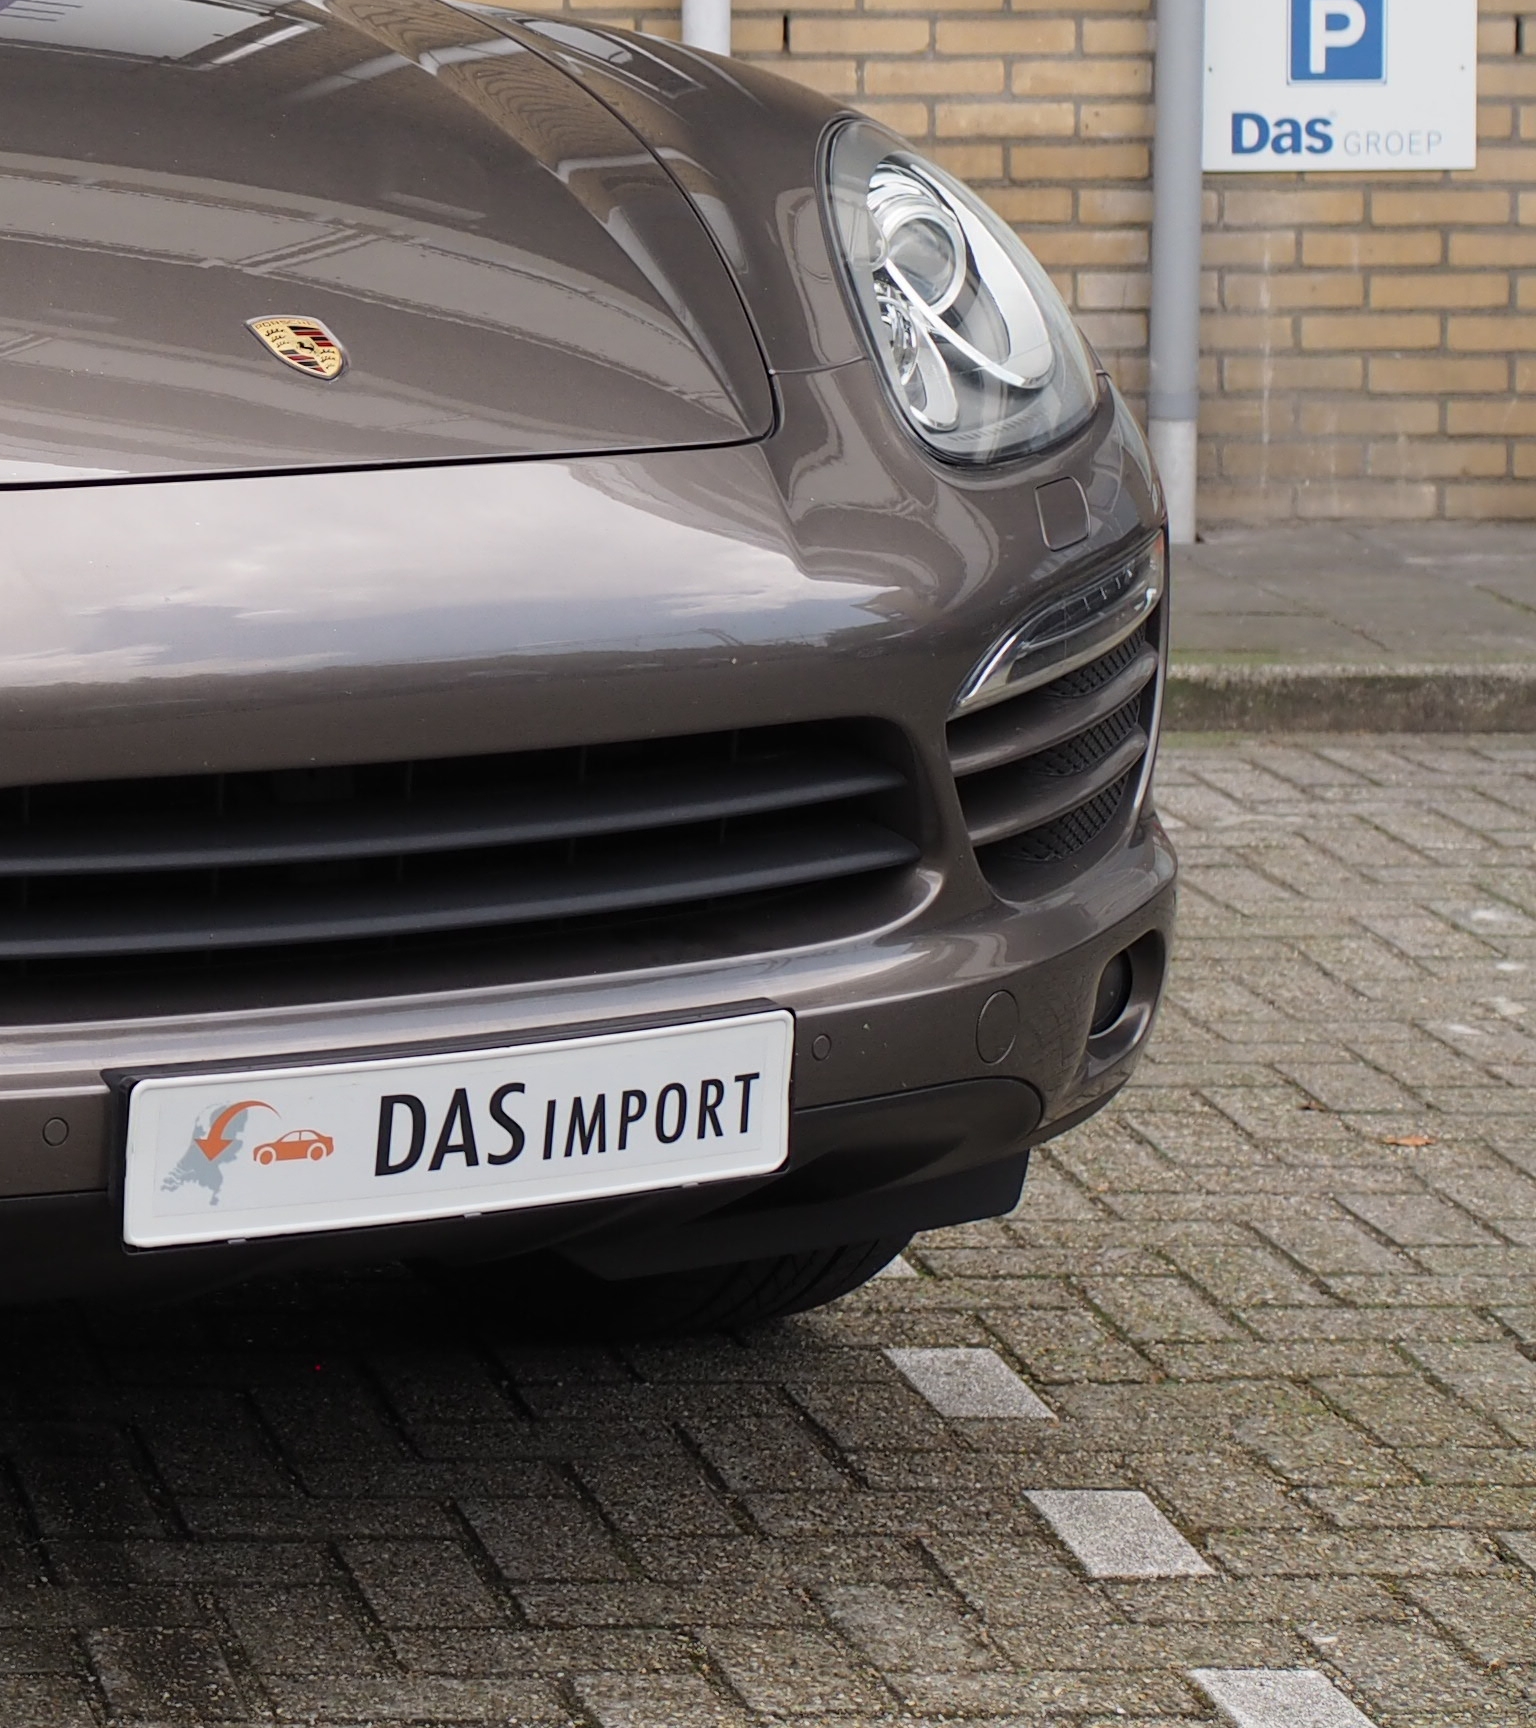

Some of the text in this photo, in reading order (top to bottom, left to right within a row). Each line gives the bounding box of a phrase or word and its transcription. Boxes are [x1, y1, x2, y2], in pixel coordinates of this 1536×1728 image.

[1231, 112, 1443, 156] Das GROEP
[374, 1072, 761, 1177] DAS IMPORT
